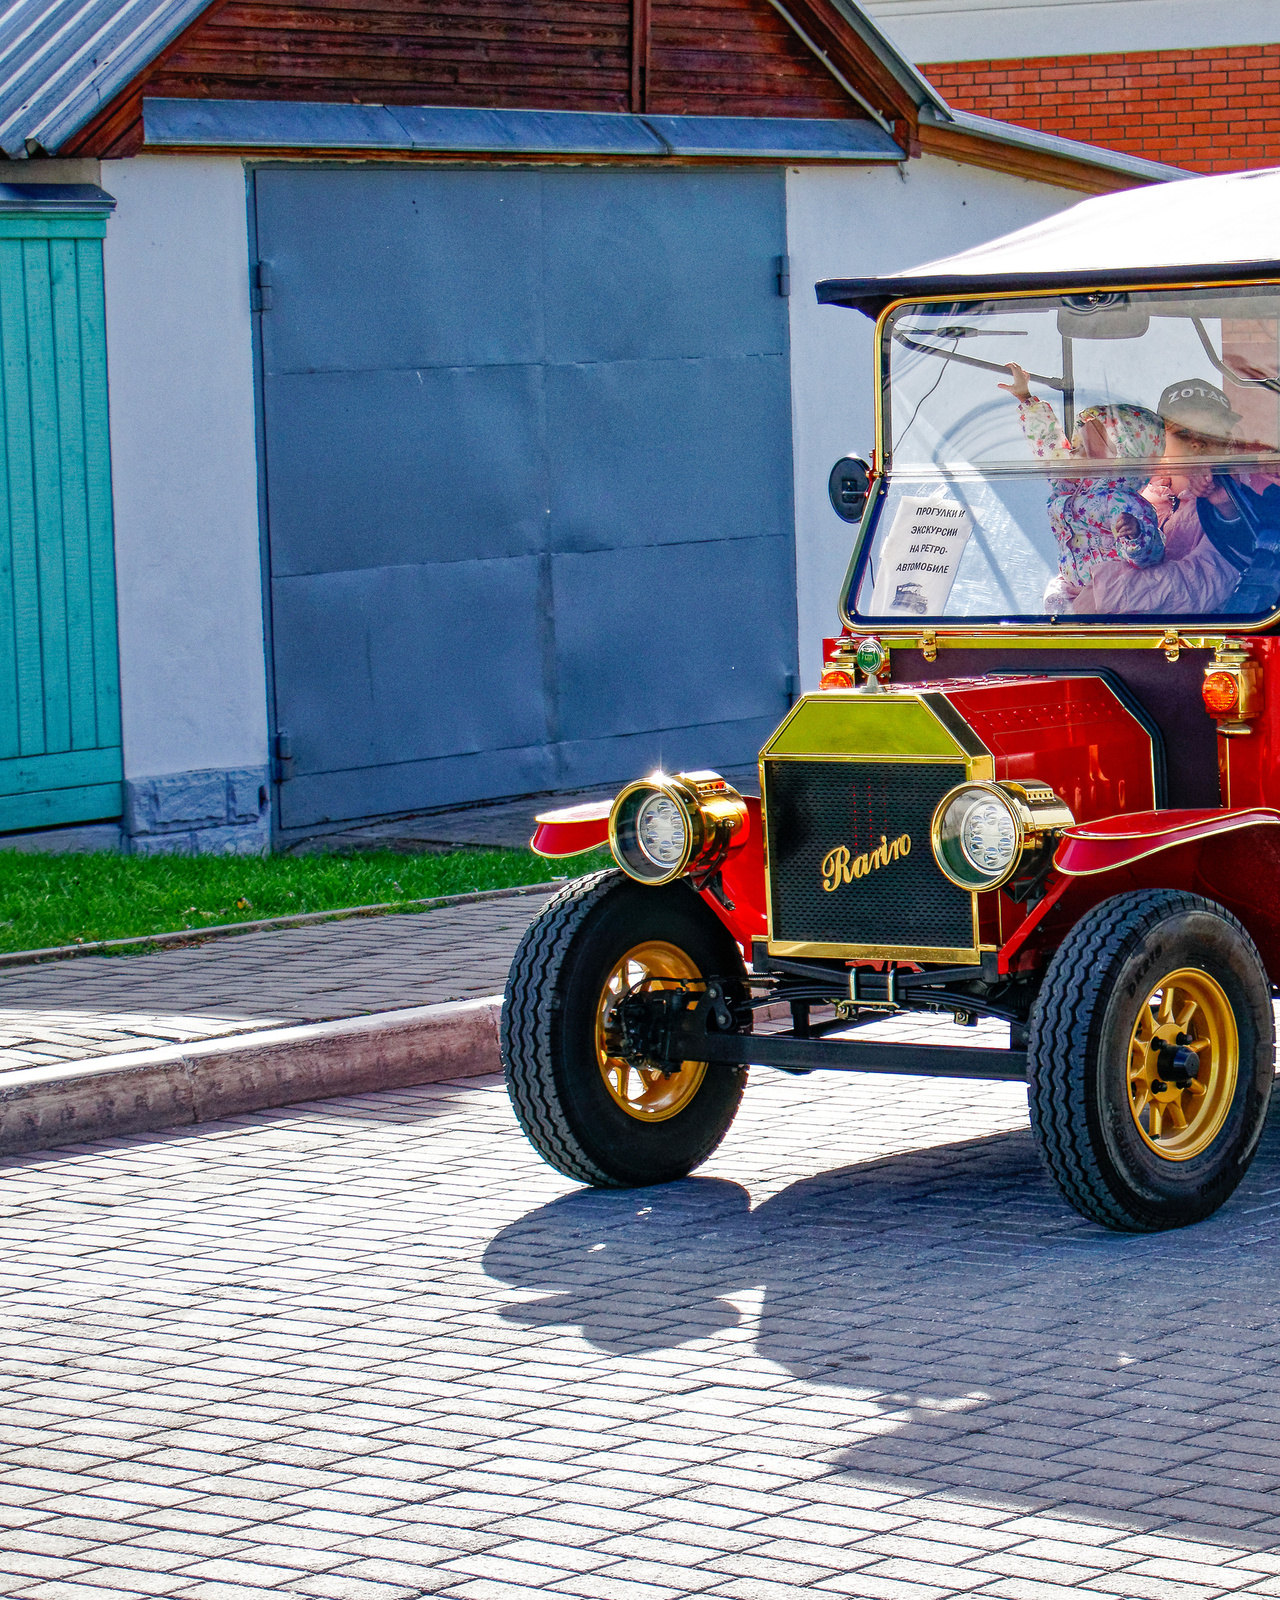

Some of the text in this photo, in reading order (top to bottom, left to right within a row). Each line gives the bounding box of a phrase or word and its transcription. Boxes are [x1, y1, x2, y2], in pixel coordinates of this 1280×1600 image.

[1168, 387, 1229, 409] ZOTAC
[915, 507, 966, 518] ПРОГУЛКИ И
[910, 526, 958, 536] ЭКСКУРСИИ
[909, 543, 948, 555] НА РЕТРО-
[895, 562, 950, 574] АВТОМОБИЛЕ
